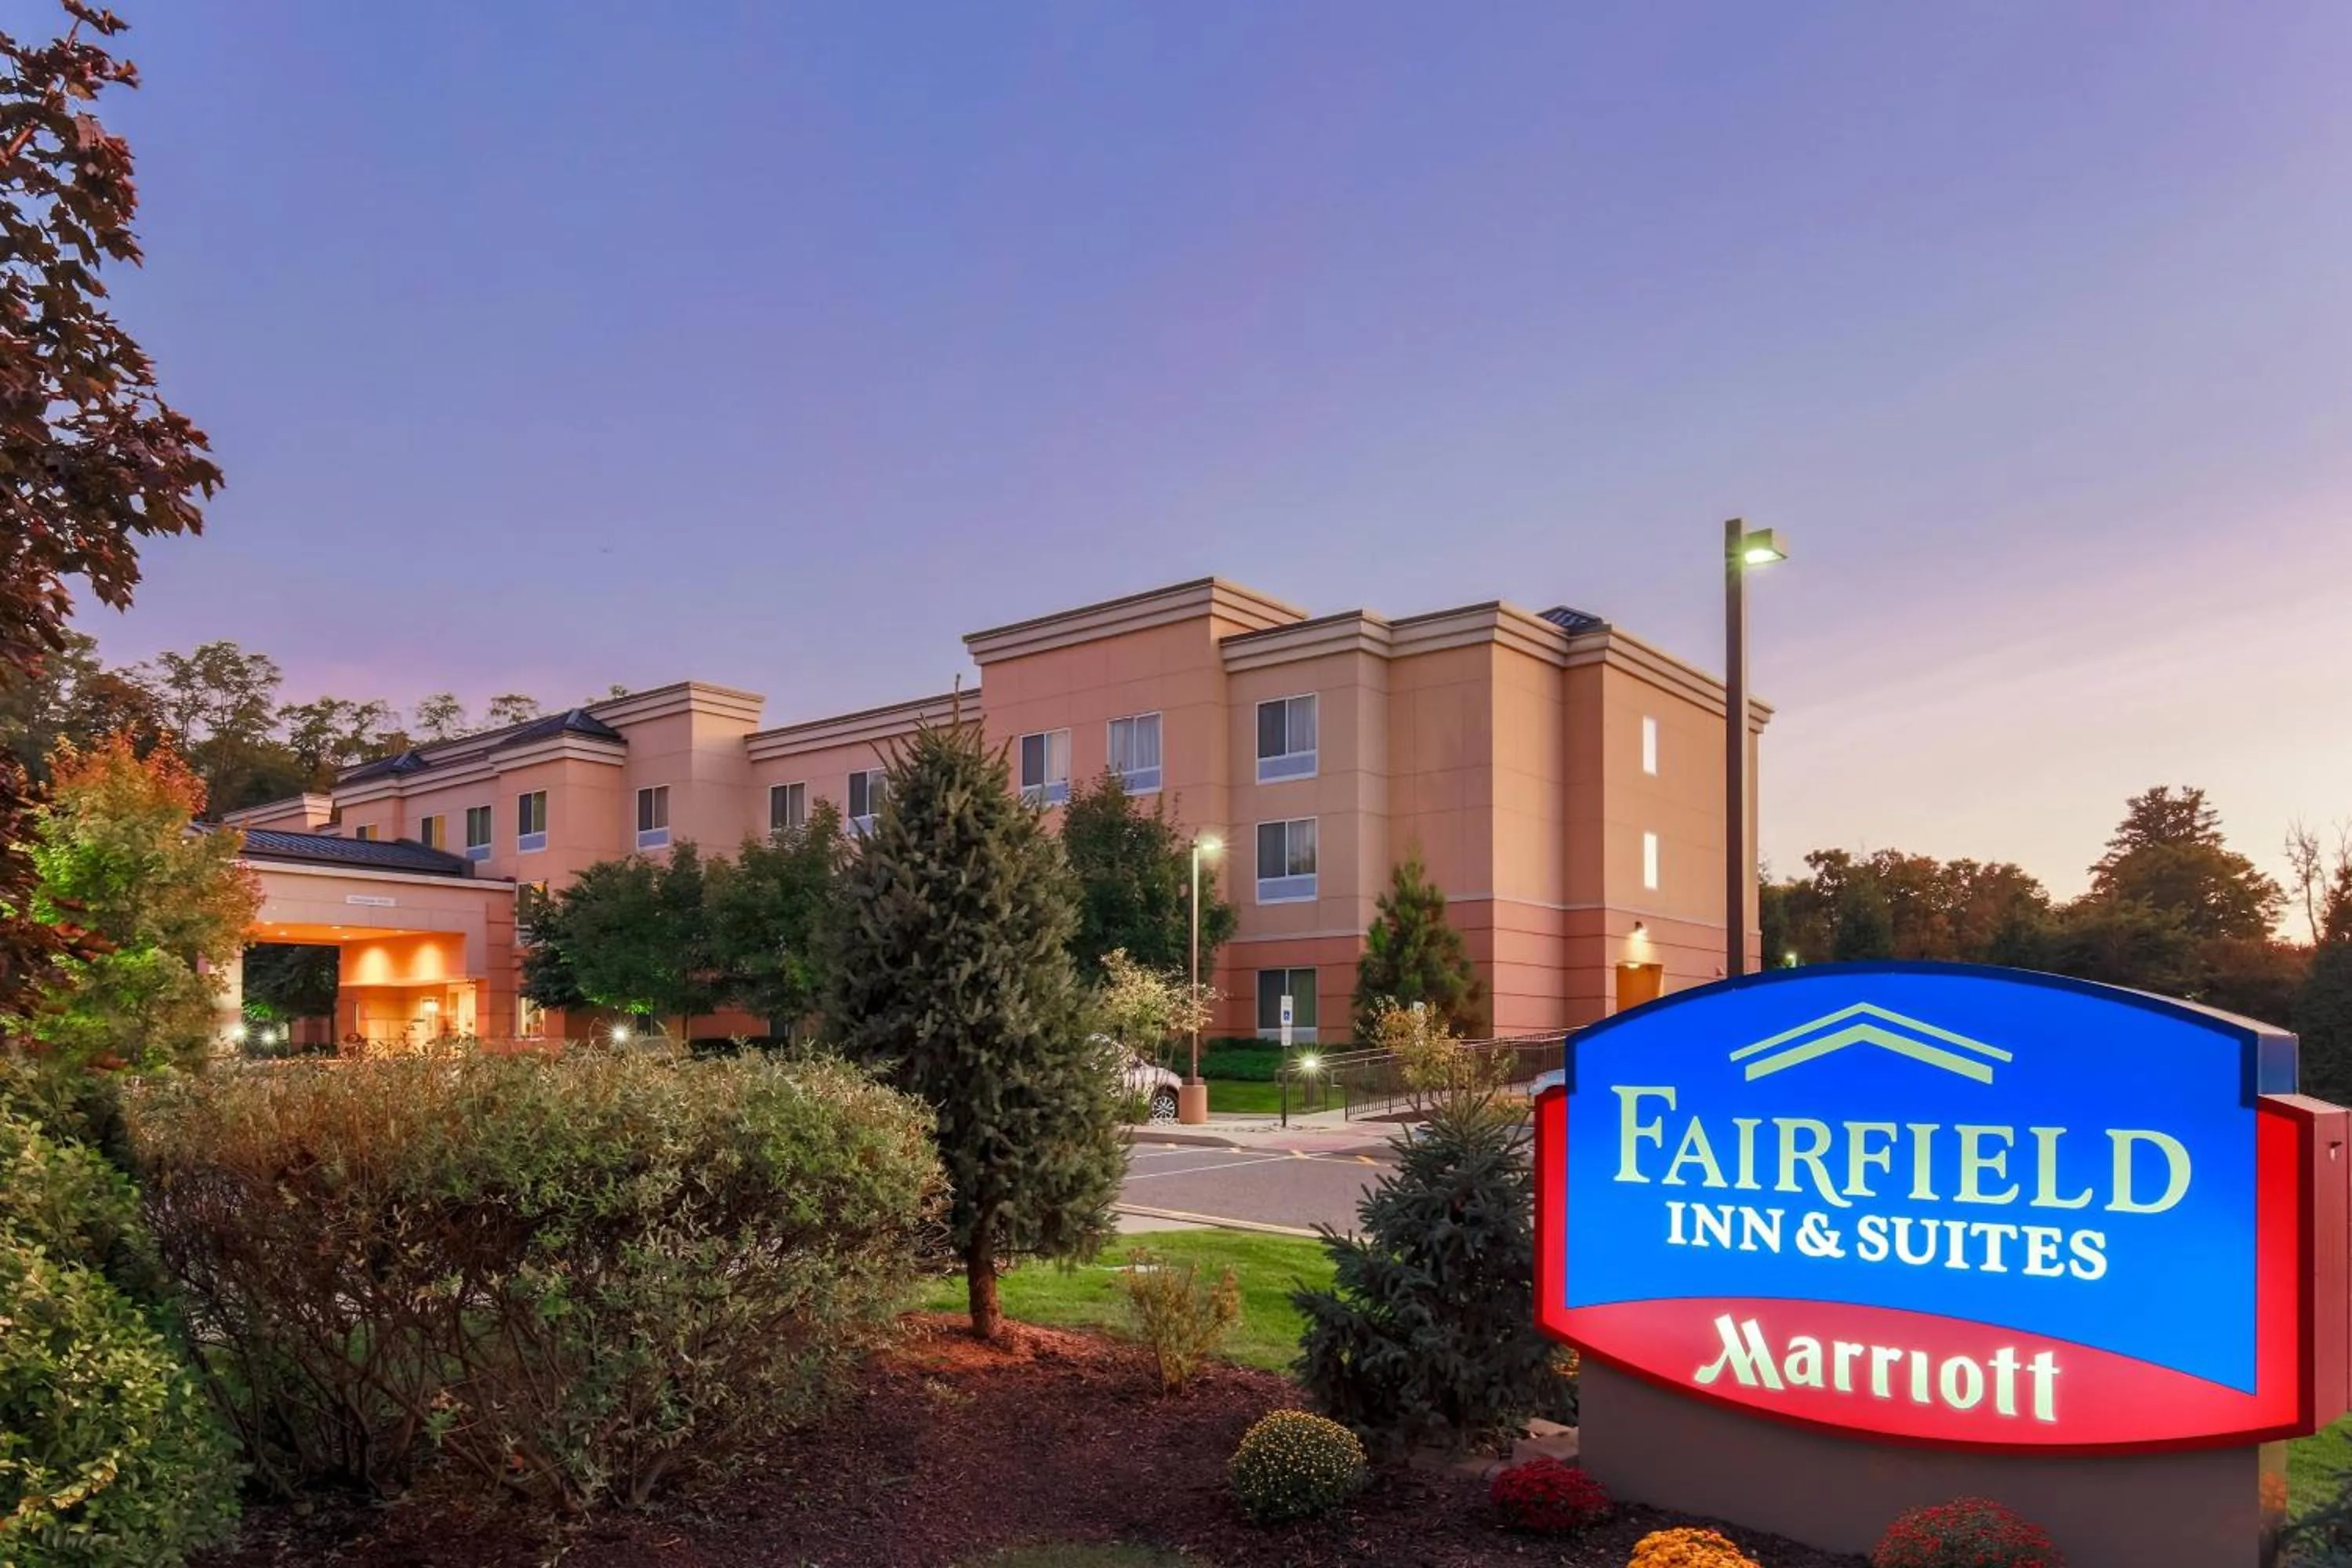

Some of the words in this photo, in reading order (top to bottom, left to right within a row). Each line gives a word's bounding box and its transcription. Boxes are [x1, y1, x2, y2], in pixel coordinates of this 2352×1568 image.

[1610, 1085, 2192, 1214] FAIRFIELD
[1665, 1200, 1785, 1254] INN
[1795, 1210, 1846, 1259] &
[1857, 1214, 2108, 1281] SUITES
[1693, 1312, 2062, 1422] Marriott
